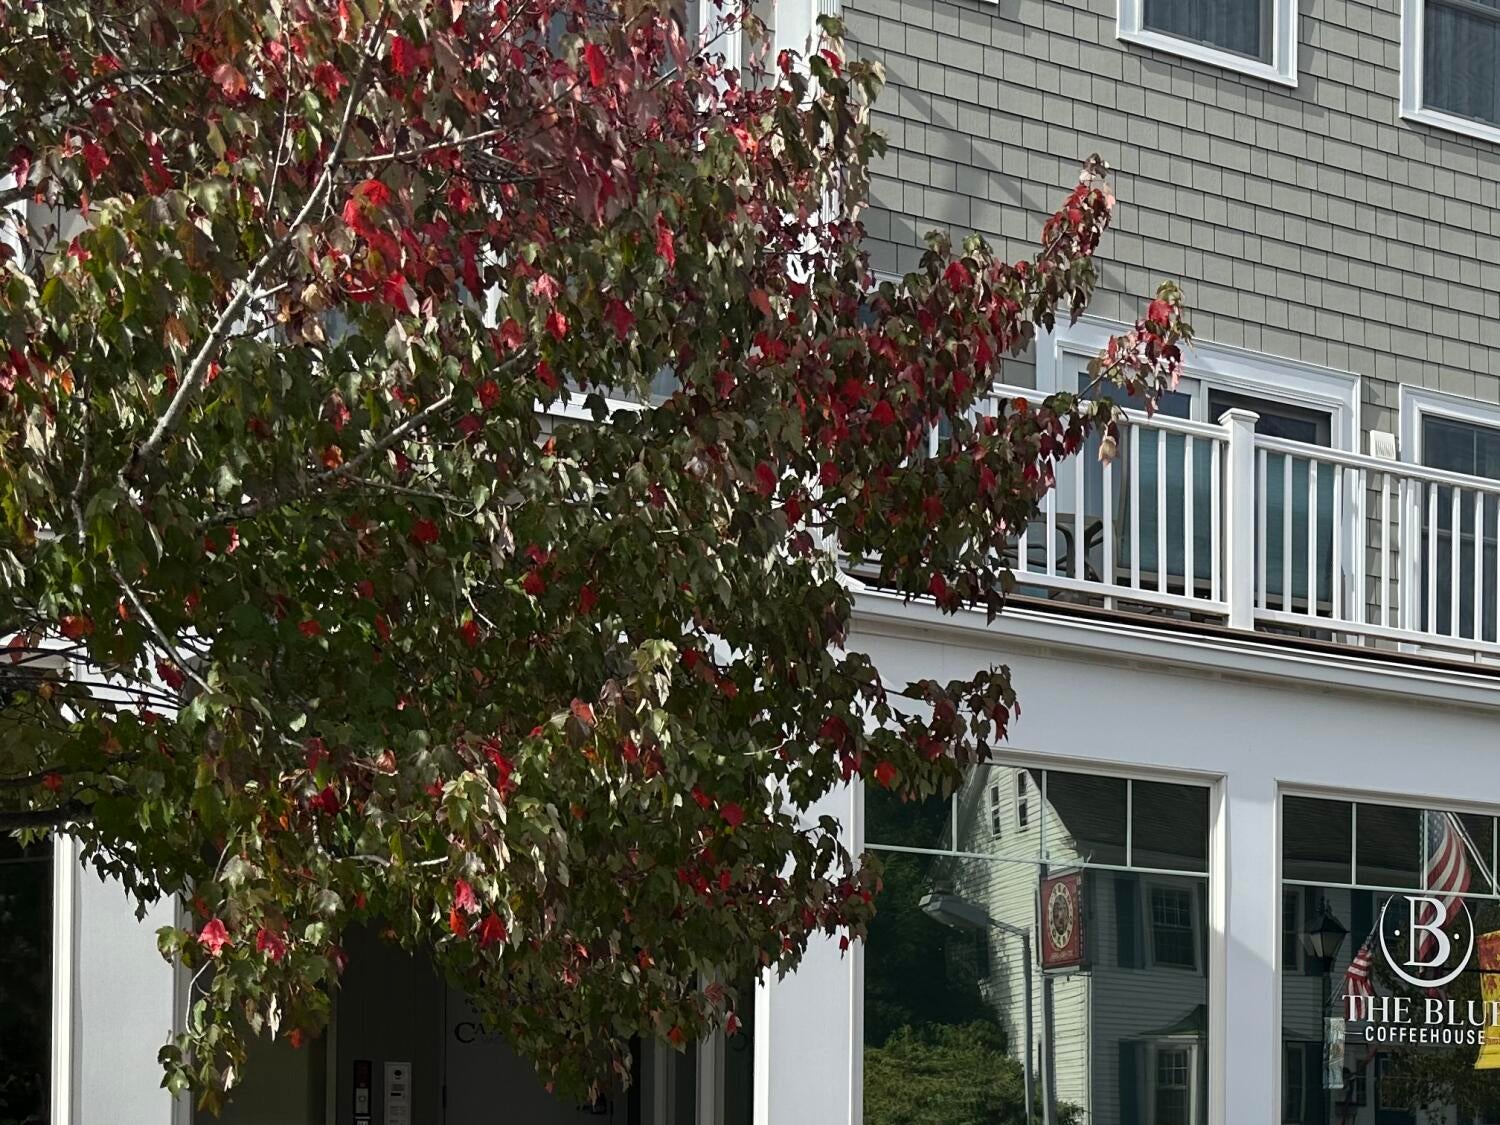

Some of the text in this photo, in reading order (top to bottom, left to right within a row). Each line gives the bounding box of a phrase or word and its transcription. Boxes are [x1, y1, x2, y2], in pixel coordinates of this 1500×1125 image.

[1403, 895, 1451, 967] B
[1342, 994, 1412, 1024] THE
[1364, 1025, 1487, 1046] COFFEEHOUSE
